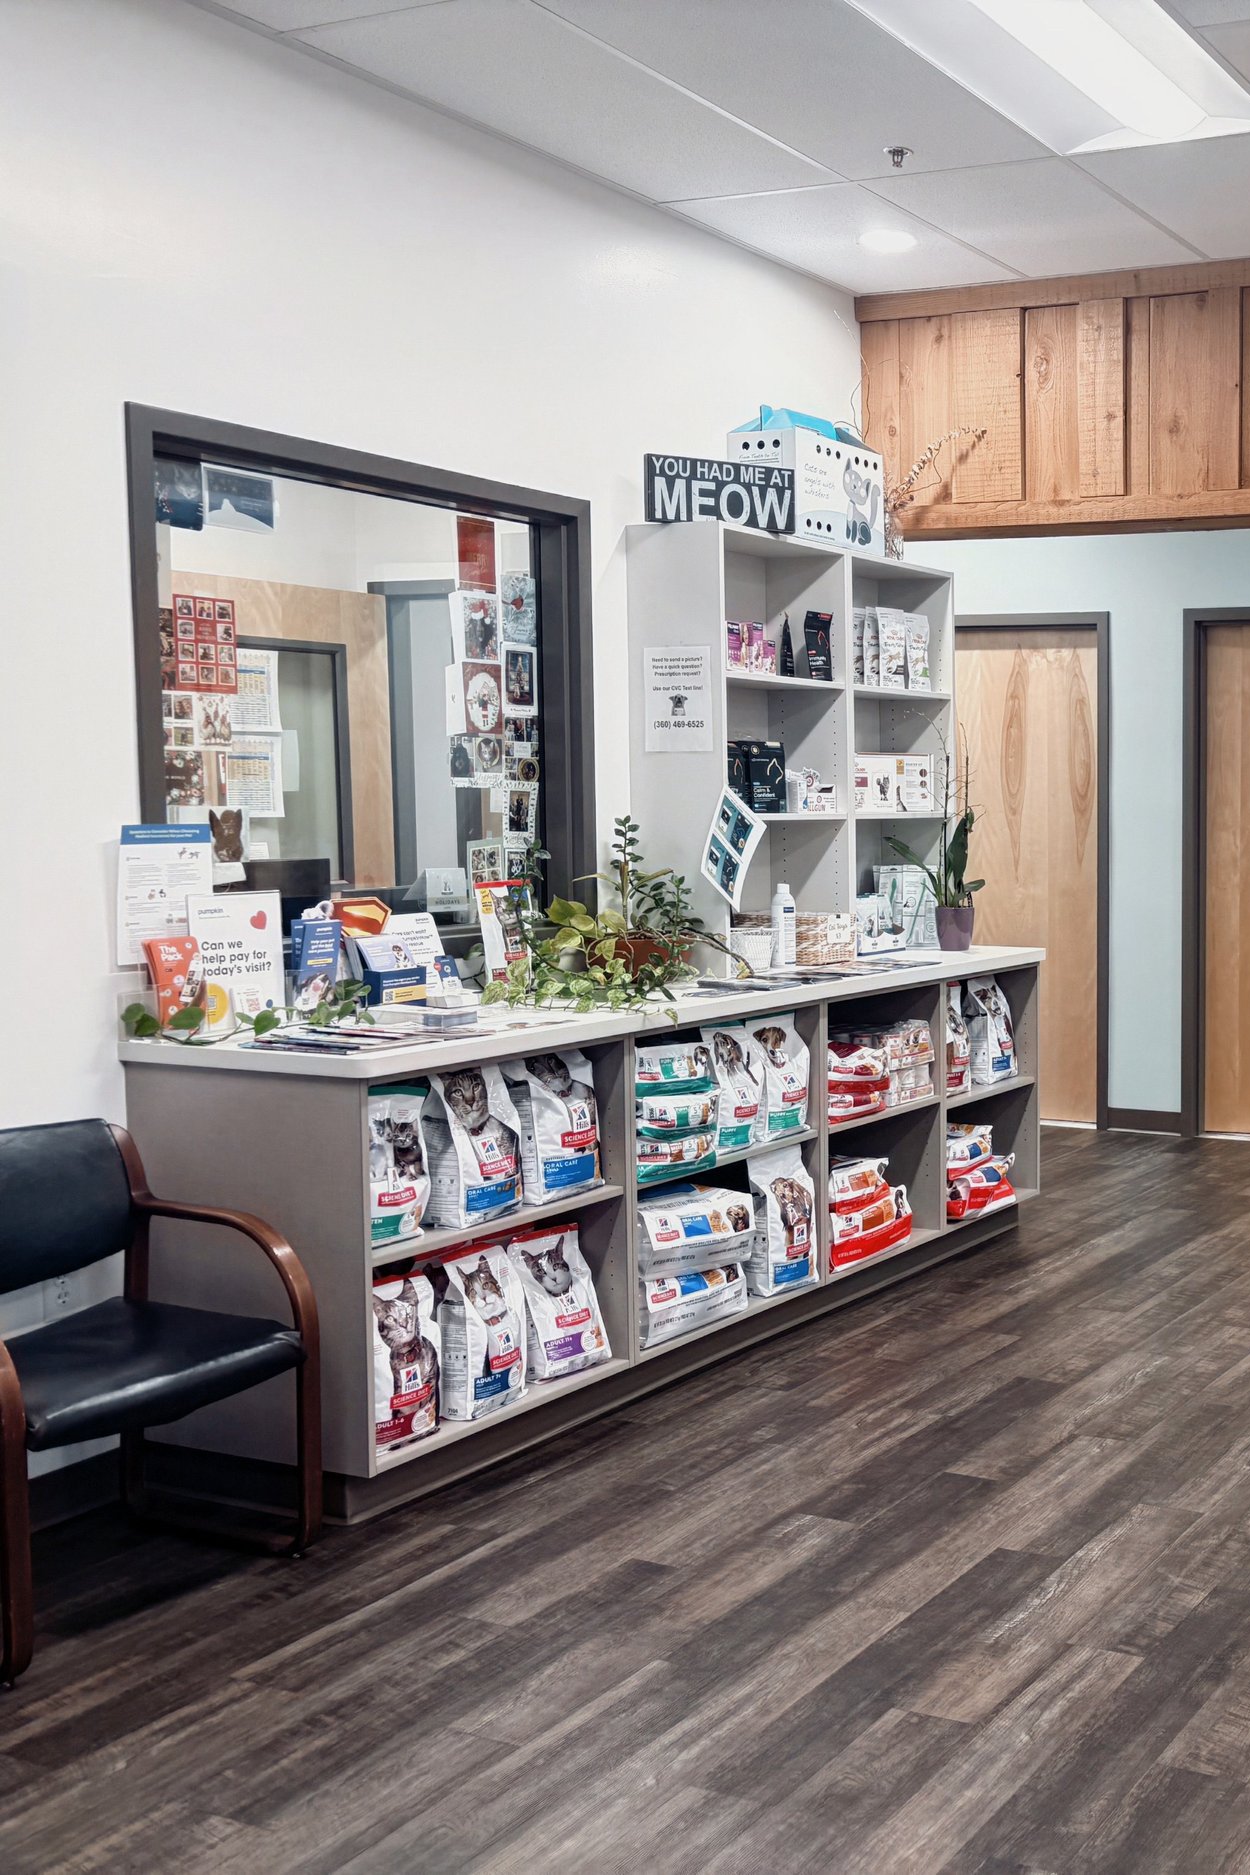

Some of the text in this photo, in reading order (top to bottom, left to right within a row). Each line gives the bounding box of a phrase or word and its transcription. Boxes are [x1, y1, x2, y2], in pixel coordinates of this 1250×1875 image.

[652, 456, 792, 487] YOU HAD ME AT
[654, 476, 791, 530] MEOW
[653, 720, 704, 730] (360) 469-6525
[198, 908, 223, 916] pumpkin
[159, 945, 177, 954] The
[201, 940, 243, 951] Can we
[161, 952, 183, 962] Pack
[202, 950, 267, 964] help pay for
[203, 961, 271, 977] today's visit?
[564, 1133, 587, 1142] SCIENCE
[546, 1338, 564, 1348] ADULT
[493, 1355, 510, 1365] SCIENCE
[476, 1375, 495, 1384] ADULT
[393, 1393, 416, 1405] SCIENCE
[376, 1420, 394, 1429] DULT
